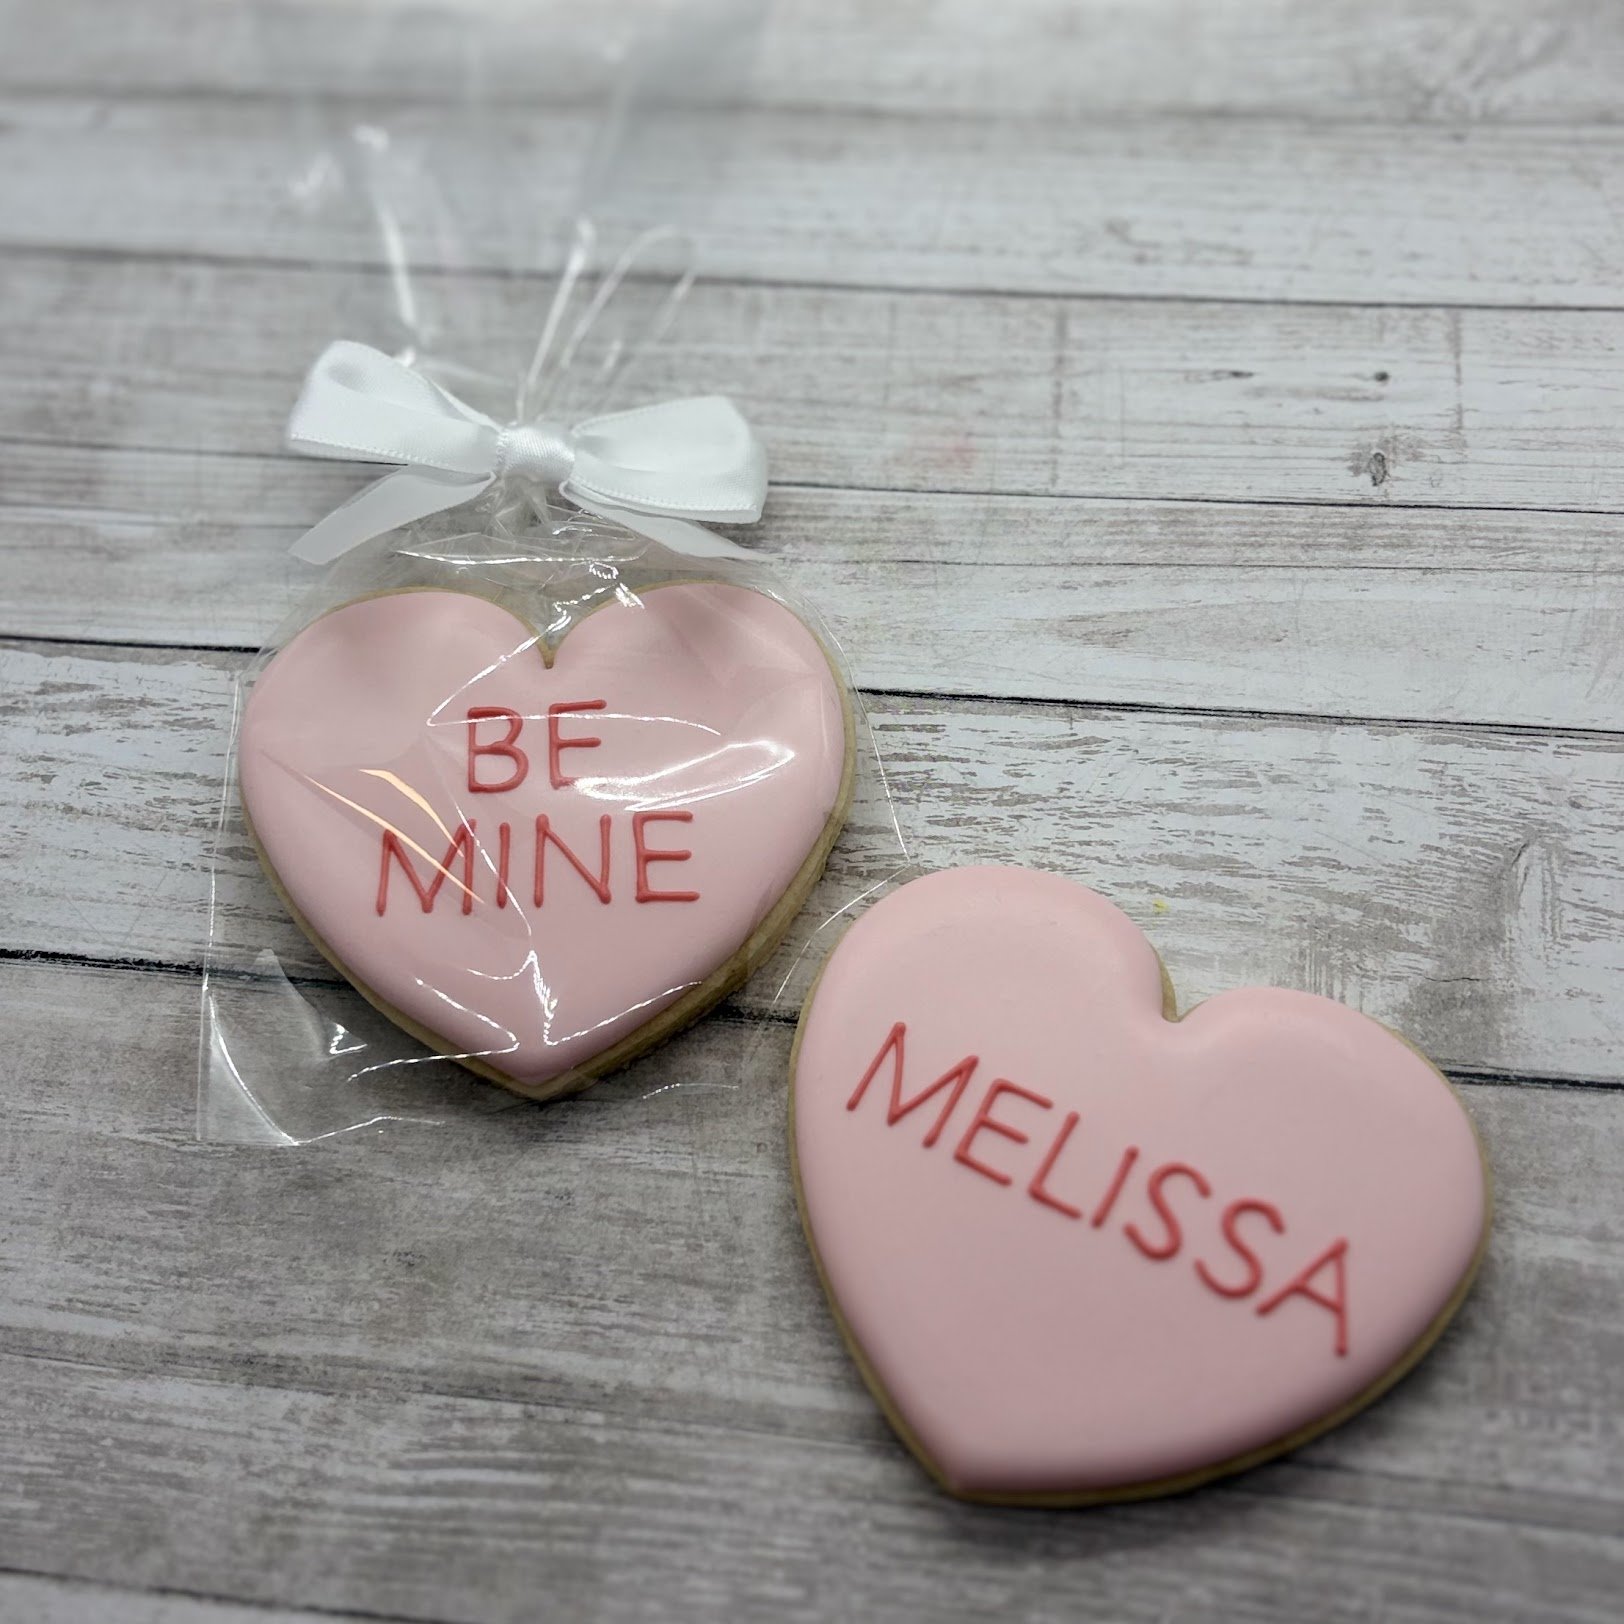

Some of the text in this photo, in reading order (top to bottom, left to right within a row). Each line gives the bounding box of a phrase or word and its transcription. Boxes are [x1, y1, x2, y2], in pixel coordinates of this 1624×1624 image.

[466, 698, 608, 794] BE
[375, 810, 701, 916] MINE
[846, 1021, 1350, 1356] MELISSA
